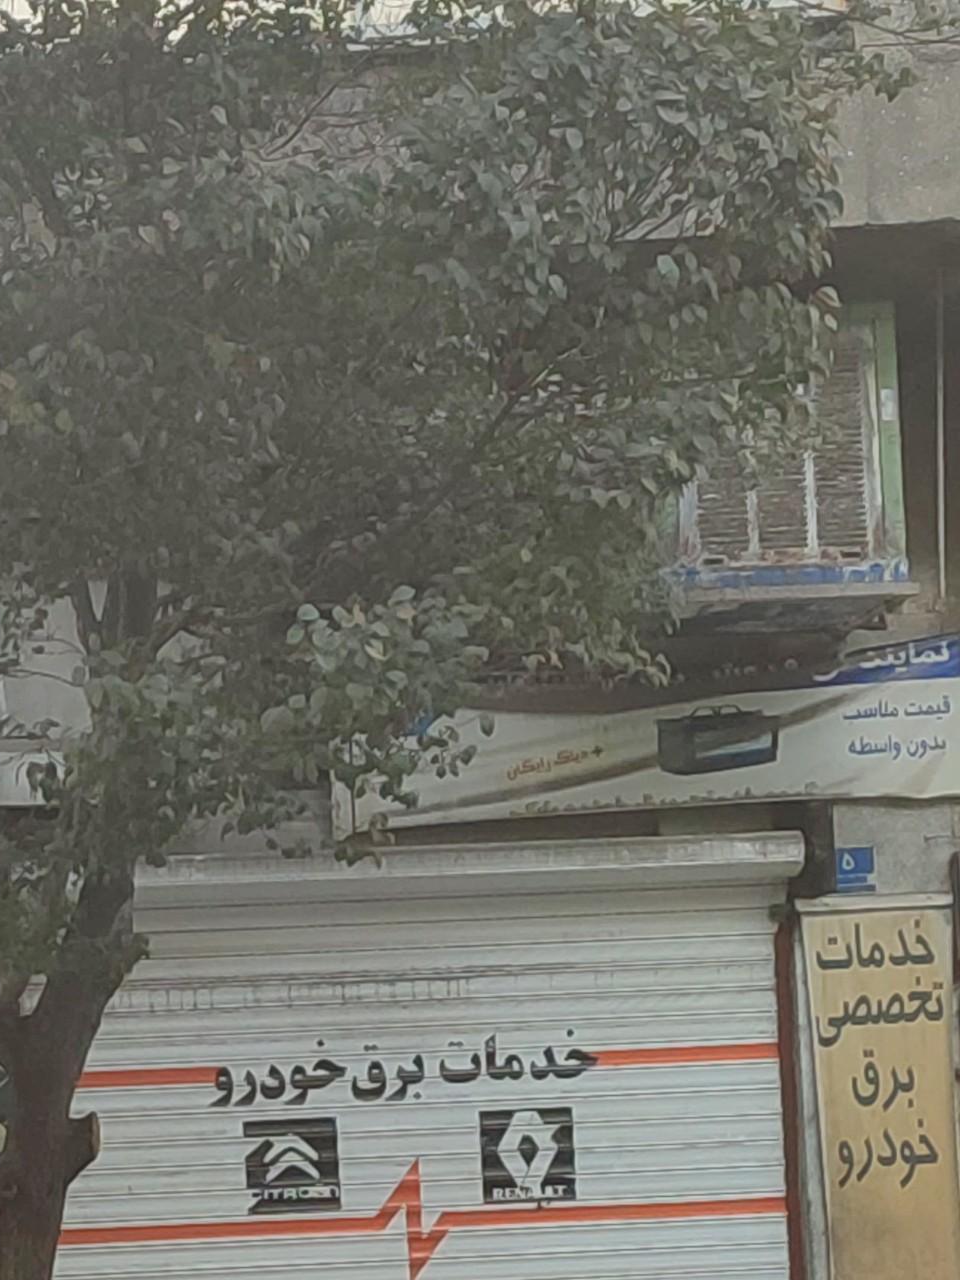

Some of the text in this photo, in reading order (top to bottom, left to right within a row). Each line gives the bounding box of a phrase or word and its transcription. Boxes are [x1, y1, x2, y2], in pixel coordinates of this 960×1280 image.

[903, 695, 950, 720] قیمت
[848, 735, 946, 760] بدون واسطه
[816, 919, 935, 970] خدمات
[816, 976, 944, 1047] تخصصی
[211, 1029, 599, 1106] خدمات برق خودرو
[852, 1050, 915, 1111] برق
[838, 1119, 938, 1188] خودرو
